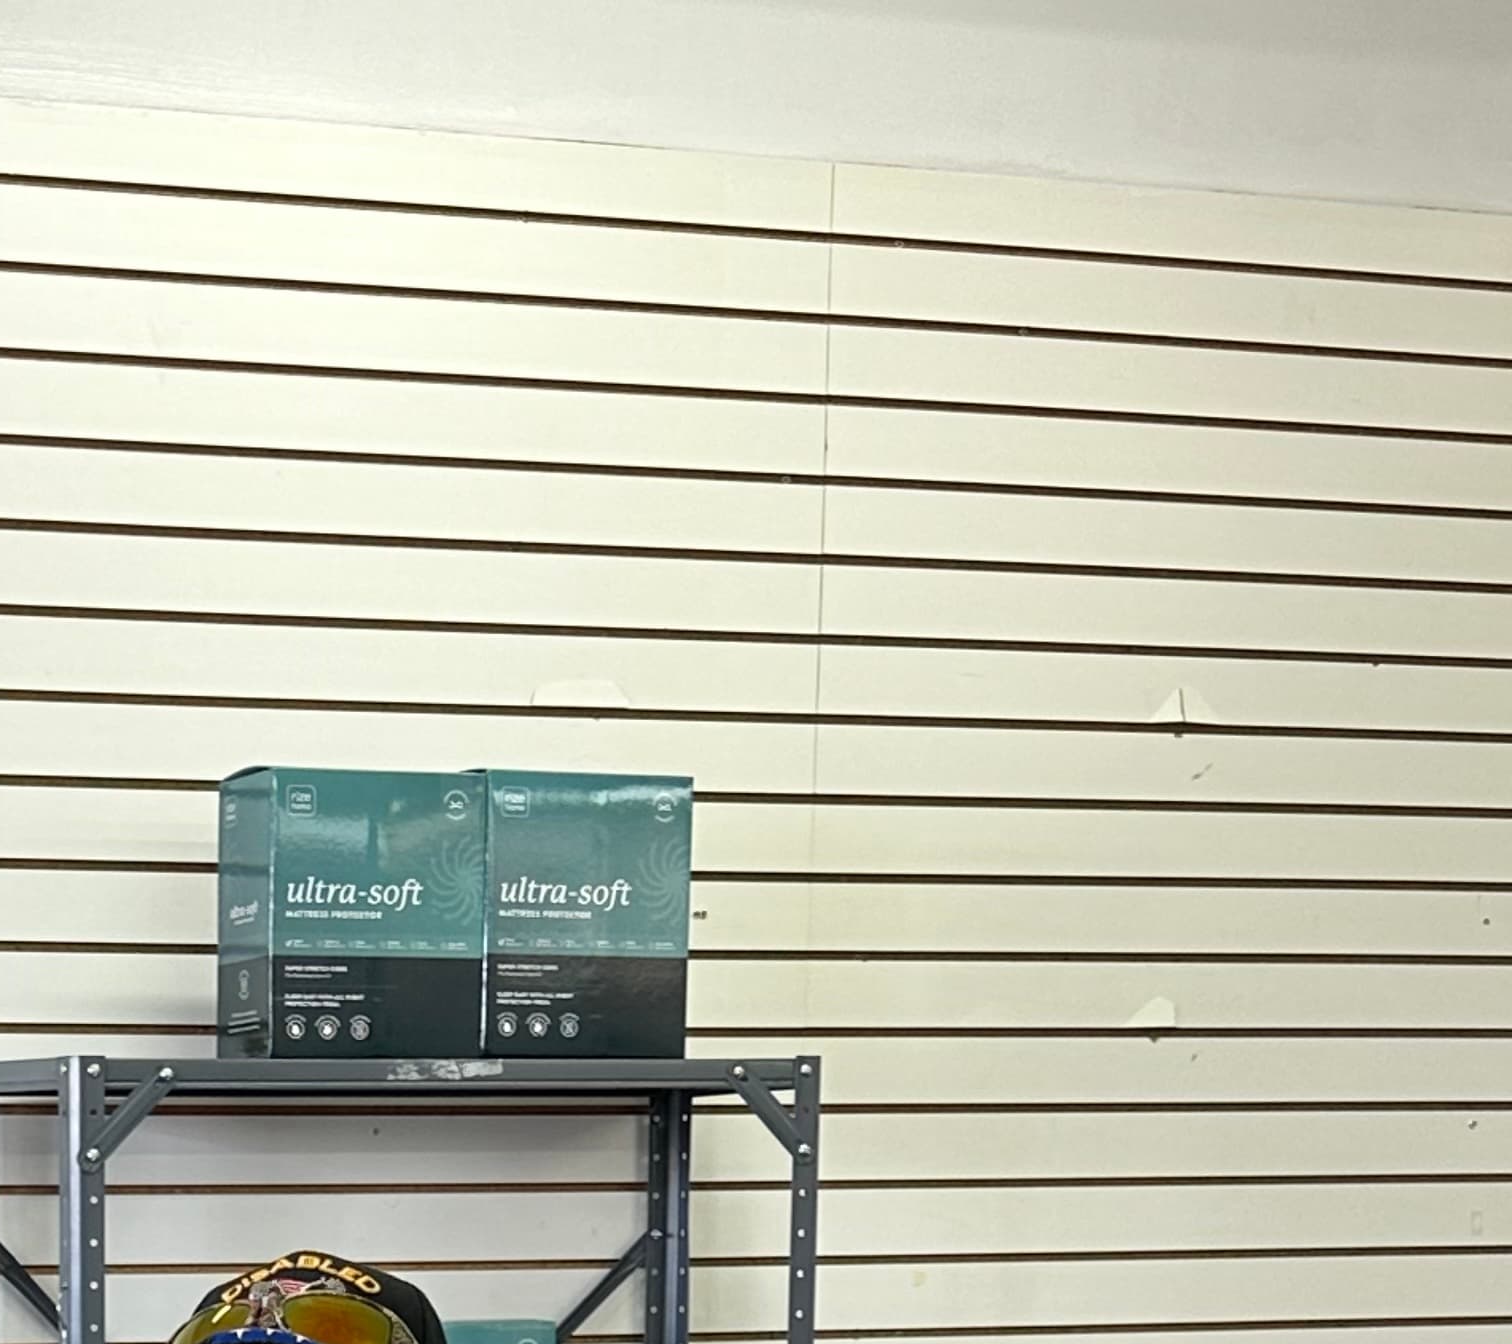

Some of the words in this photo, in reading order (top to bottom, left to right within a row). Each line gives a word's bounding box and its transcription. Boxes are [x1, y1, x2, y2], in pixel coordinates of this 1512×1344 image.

[287, 876, 424, 911] ultra-soft
[500, 876, 633, 911] ultra-soft
[220, 1254, 382, 1303] DISABLED
